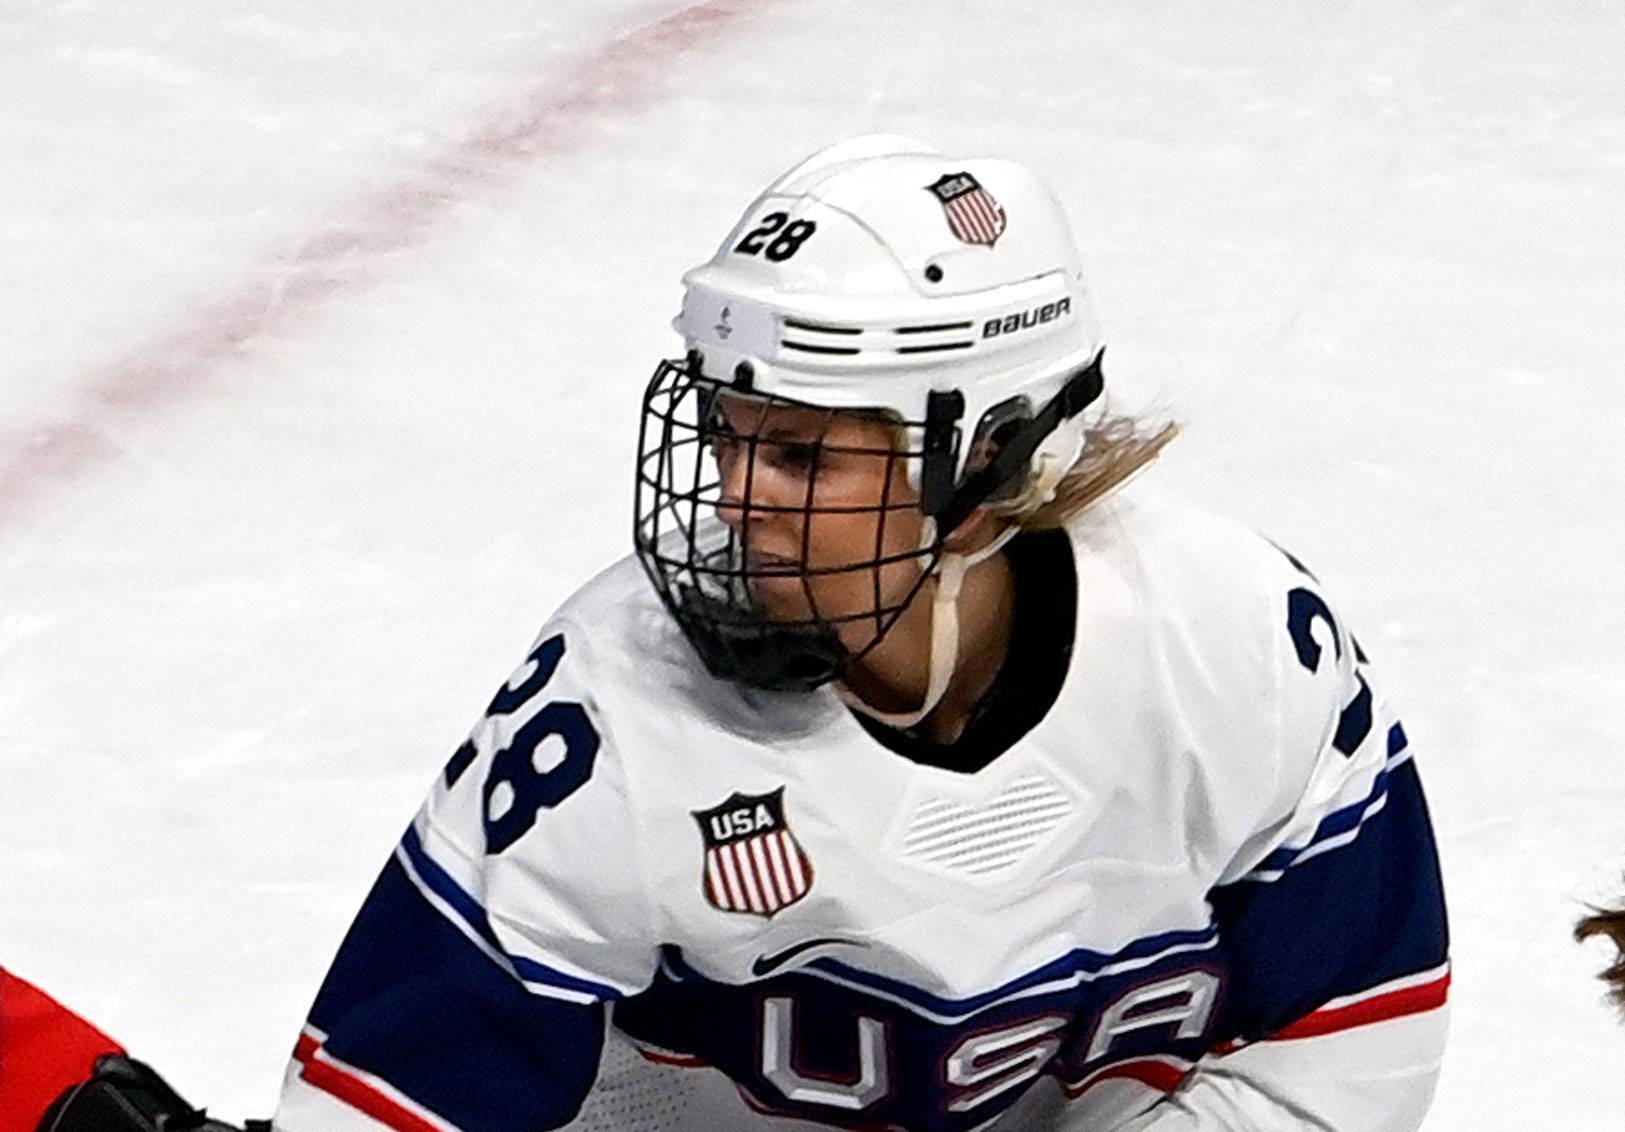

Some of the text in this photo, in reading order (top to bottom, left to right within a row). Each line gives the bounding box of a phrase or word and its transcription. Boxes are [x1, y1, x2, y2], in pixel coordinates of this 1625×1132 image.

[733, 210, 817, 262] 28
[982, 296, 1071, 339] BAUER
[1281, 584, 1374, 760] 2
[443, 632, 602, 857] 28
[710, 804, 774, 842] USA
[761, 969, 1221, 1112] USA
